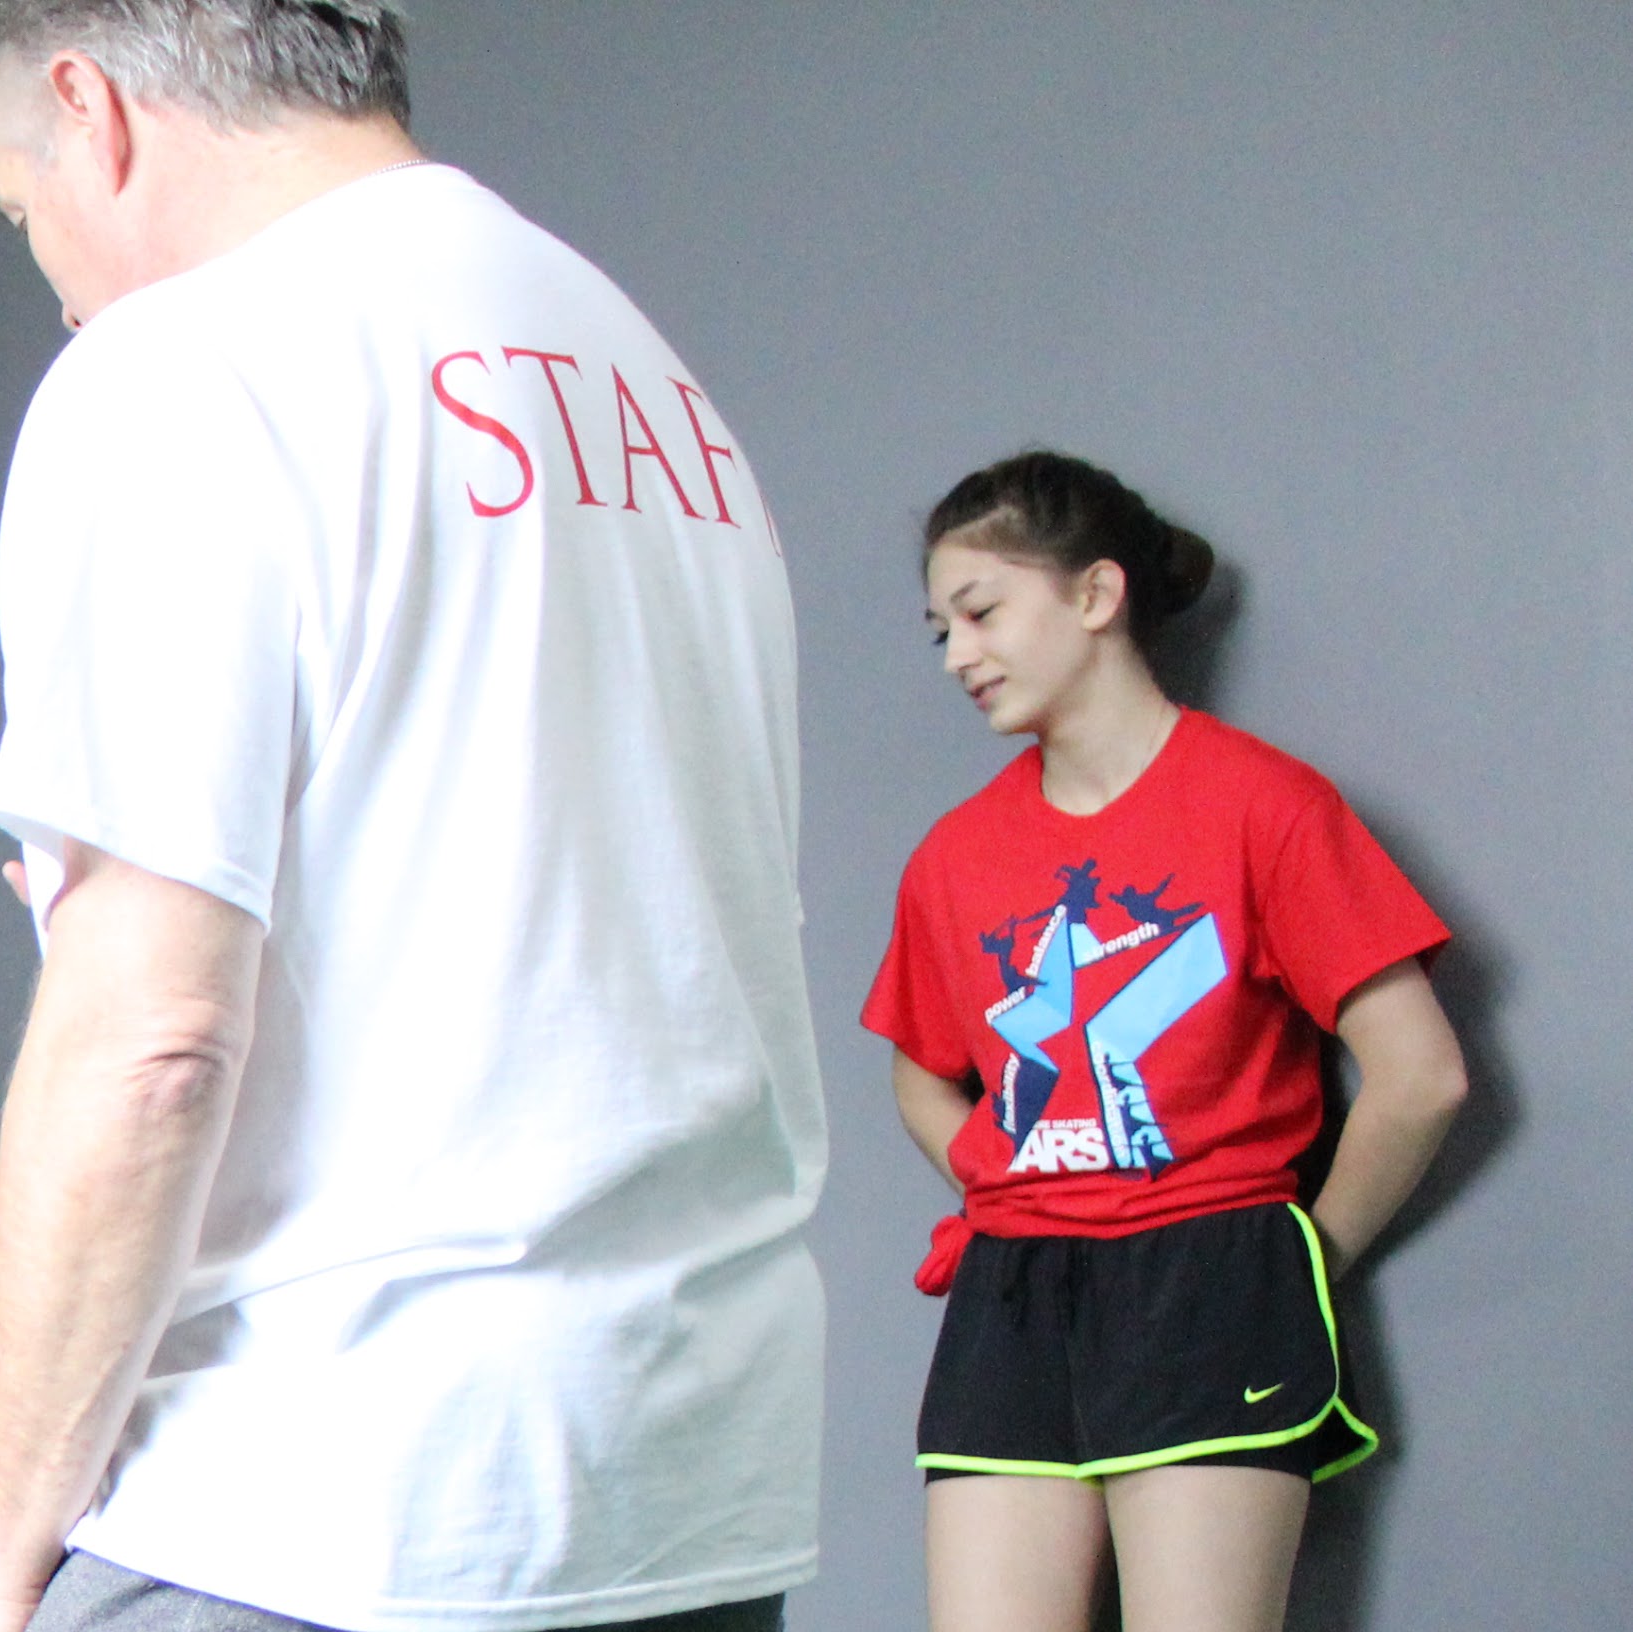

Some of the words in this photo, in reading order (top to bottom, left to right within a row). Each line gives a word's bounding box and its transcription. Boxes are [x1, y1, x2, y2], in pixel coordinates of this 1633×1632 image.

[432, 345, 781, 557] STAF
[1025, 904, 1067, 978] balance
[985, 987, 1026, 1025] power
